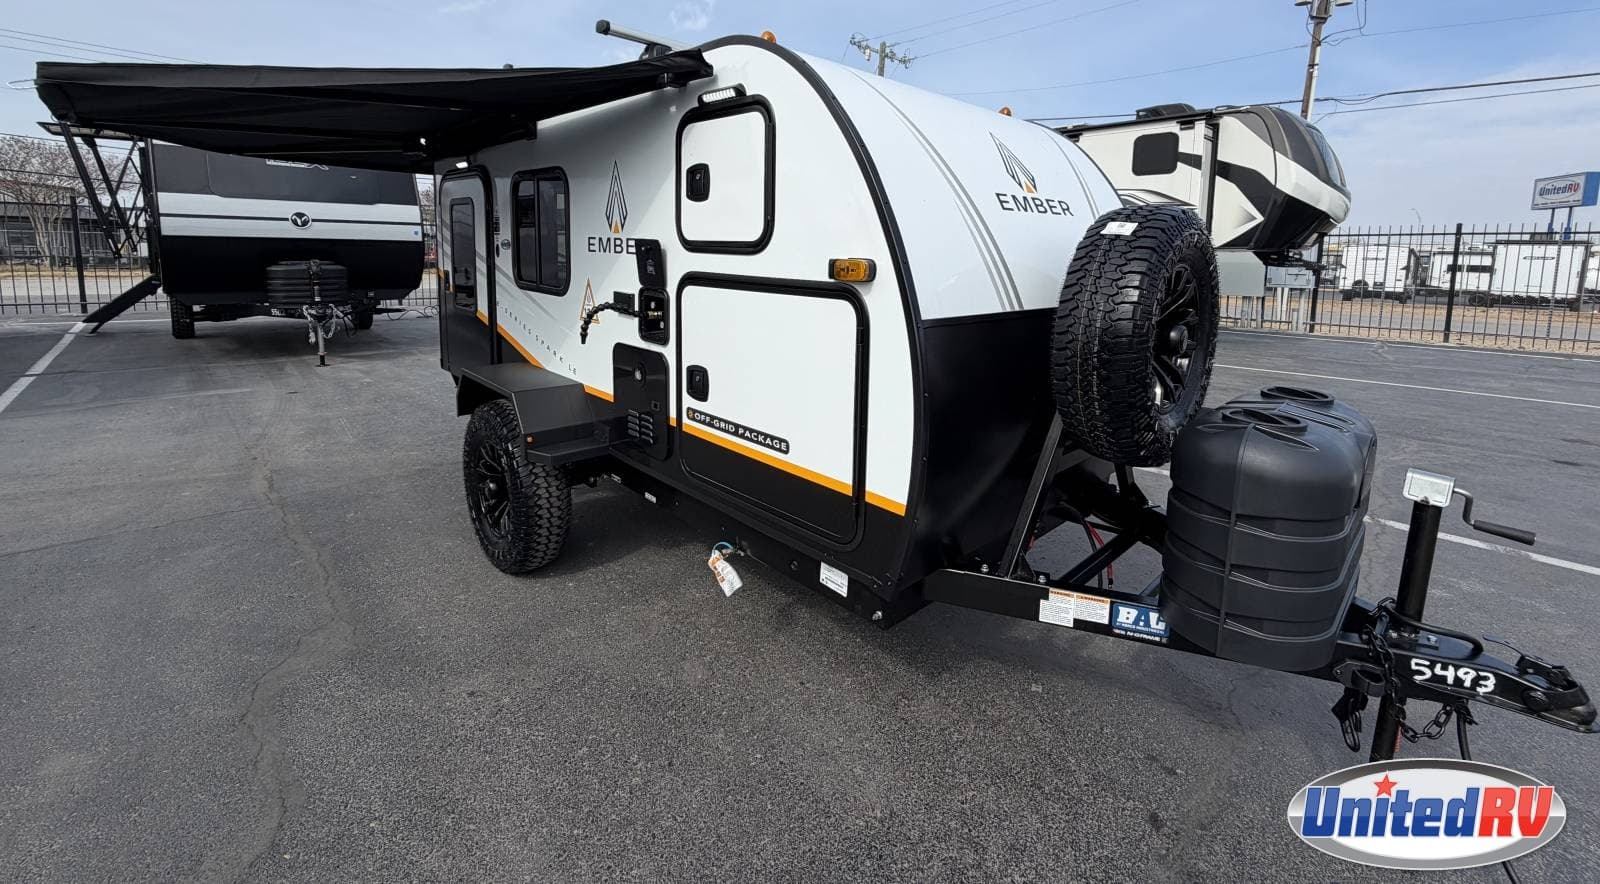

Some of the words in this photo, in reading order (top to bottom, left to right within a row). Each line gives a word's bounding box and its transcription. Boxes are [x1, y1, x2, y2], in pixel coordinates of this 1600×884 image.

[1538, 182, 1580, 197] UnitedRV
[995, 192, 1074, 216] EMBER
[587, 236, 637, 255] EMBE
[535, 334, 564, 364] SPARK
[694, 411, 736, 433] OFF-GRID
[738, 427, 788, 451] PACKAGE
[1410, 657, 1497, 695] 5493
